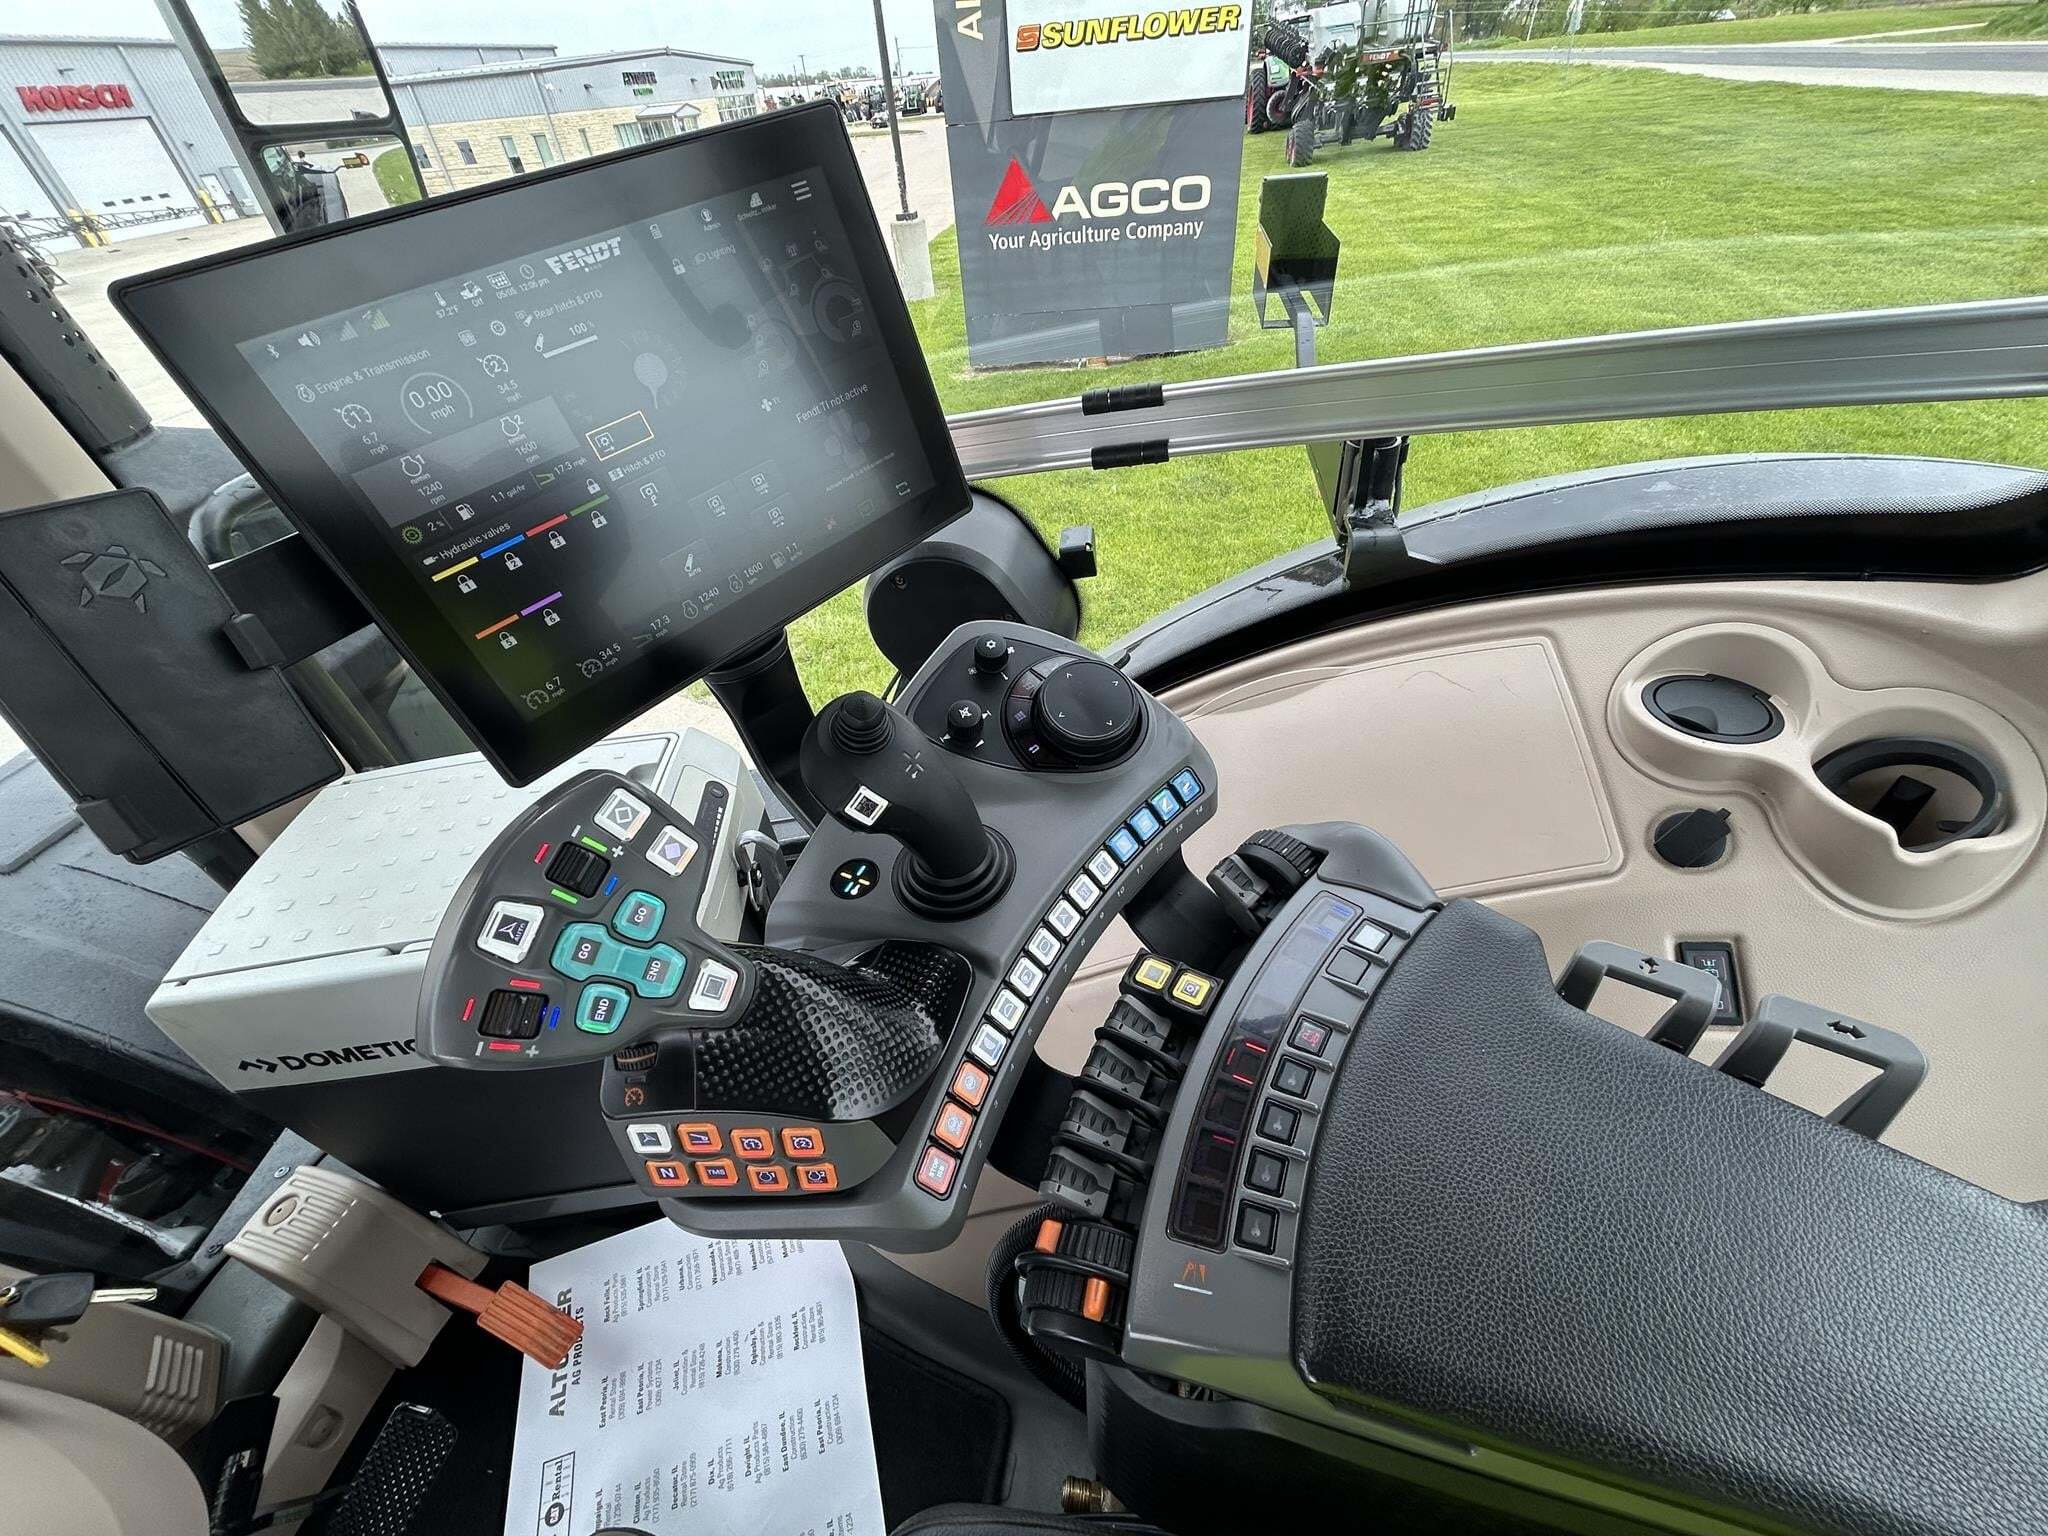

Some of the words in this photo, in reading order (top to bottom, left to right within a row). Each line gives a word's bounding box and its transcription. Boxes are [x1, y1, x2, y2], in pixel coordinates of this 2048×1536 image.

[1041, 5, 1241, 48] SUNFLOWER
[16, 84, 134, 112] HORSCH
[1051, 175, 1211, 221] AGCO
[988, 233, 1025, 250] Your
[1030, 226, 1121, 250] Agriculture
[1126, 221, 1204, 243] Company
[544, 236, 622, 276] FENDT
[583, 288, 602, 302] PTO
[568, 322, 588, 337] 100
[316, 374, 353, 394] Engine
[353, 370, 364, 382] &
[362, 349, 431, 378] Transmission
[409, 381, 452, 408] 0.00
[497, 381, 518, 394] 34.5
[831, 394, 845, 407] not
[844, 383, 869, 399] active
[431, 404, 456, 420] mph
[362, 432, 378, 445] 6.7
[370, 444, 388, 456] mph
[514, 442, 537, 457] 1600
[650, 450, 667, 460] PTO
[554, 462, 573, 476] 17.3
[418, 481, 443, 498] 1240
[491, 491, 504, 504] 1.1
[430, 494, 446, 506] rpm
[428, 522, 436, 532] 2
[440, 532, 484, 560] Hydraulic
[481, 522, 512, 540] valves
[744, 562, 764, 578] 1600
[698, 587, 720, 603] 1240
[650, 615, 670, 631] 17.3
[599, 643, 621, 660] 34.5
[546, 677, 561, 690] 6.7
[634, 907, 648, 924] GO
[514, 922, 527, 942] AUTO
[578, 942, 592, 960] GO
[646, 960, 662, 982] END
[594, 998, 610, 1022] END
[660, 1168, 674, 1178] N
[706, 1168, 726, 1177] TMS
[928, 1158, 938, 1178] STOP
[710, 1249, 718, 1285] Wauconda,
[637, 1274, 645, 1311] Springfield,
[572, 1307, 584, 1364] PRODTS
[750, 1336, 758, 1364] Oglesby,
[637, 1362, 644, 1370] IL
[572, 1370, 581, 1386] AG
[637, 1371, 645, 1397] Peoria,
[599, 1384, 608, 1410] Peoria,
[814, 1398, 821, 1407] IL
[636, 1398, 644, 1415] East
[778, 1411, 785, 1419] IL
[816, 1407, 824, 1435] Peoria,
[824, 1401, 833, 1444] Construction
[744, 1435, 750, 1444] IL
[779, 1420, 788, 1452] Dundee,
[789, 1415, 797, 1460] Construction
[672, 1465, 678, 1473] IL
[708, 1458, 715, 1466] IL
[744, 1445, 752, 1477] Dwight,
[781, 1453, 789, 1472] East
[552, 1459, 563, 1501] Rental
[634, 1482, 641, 1490] IL
[633, 1490, 641, 1524] Clinton,
